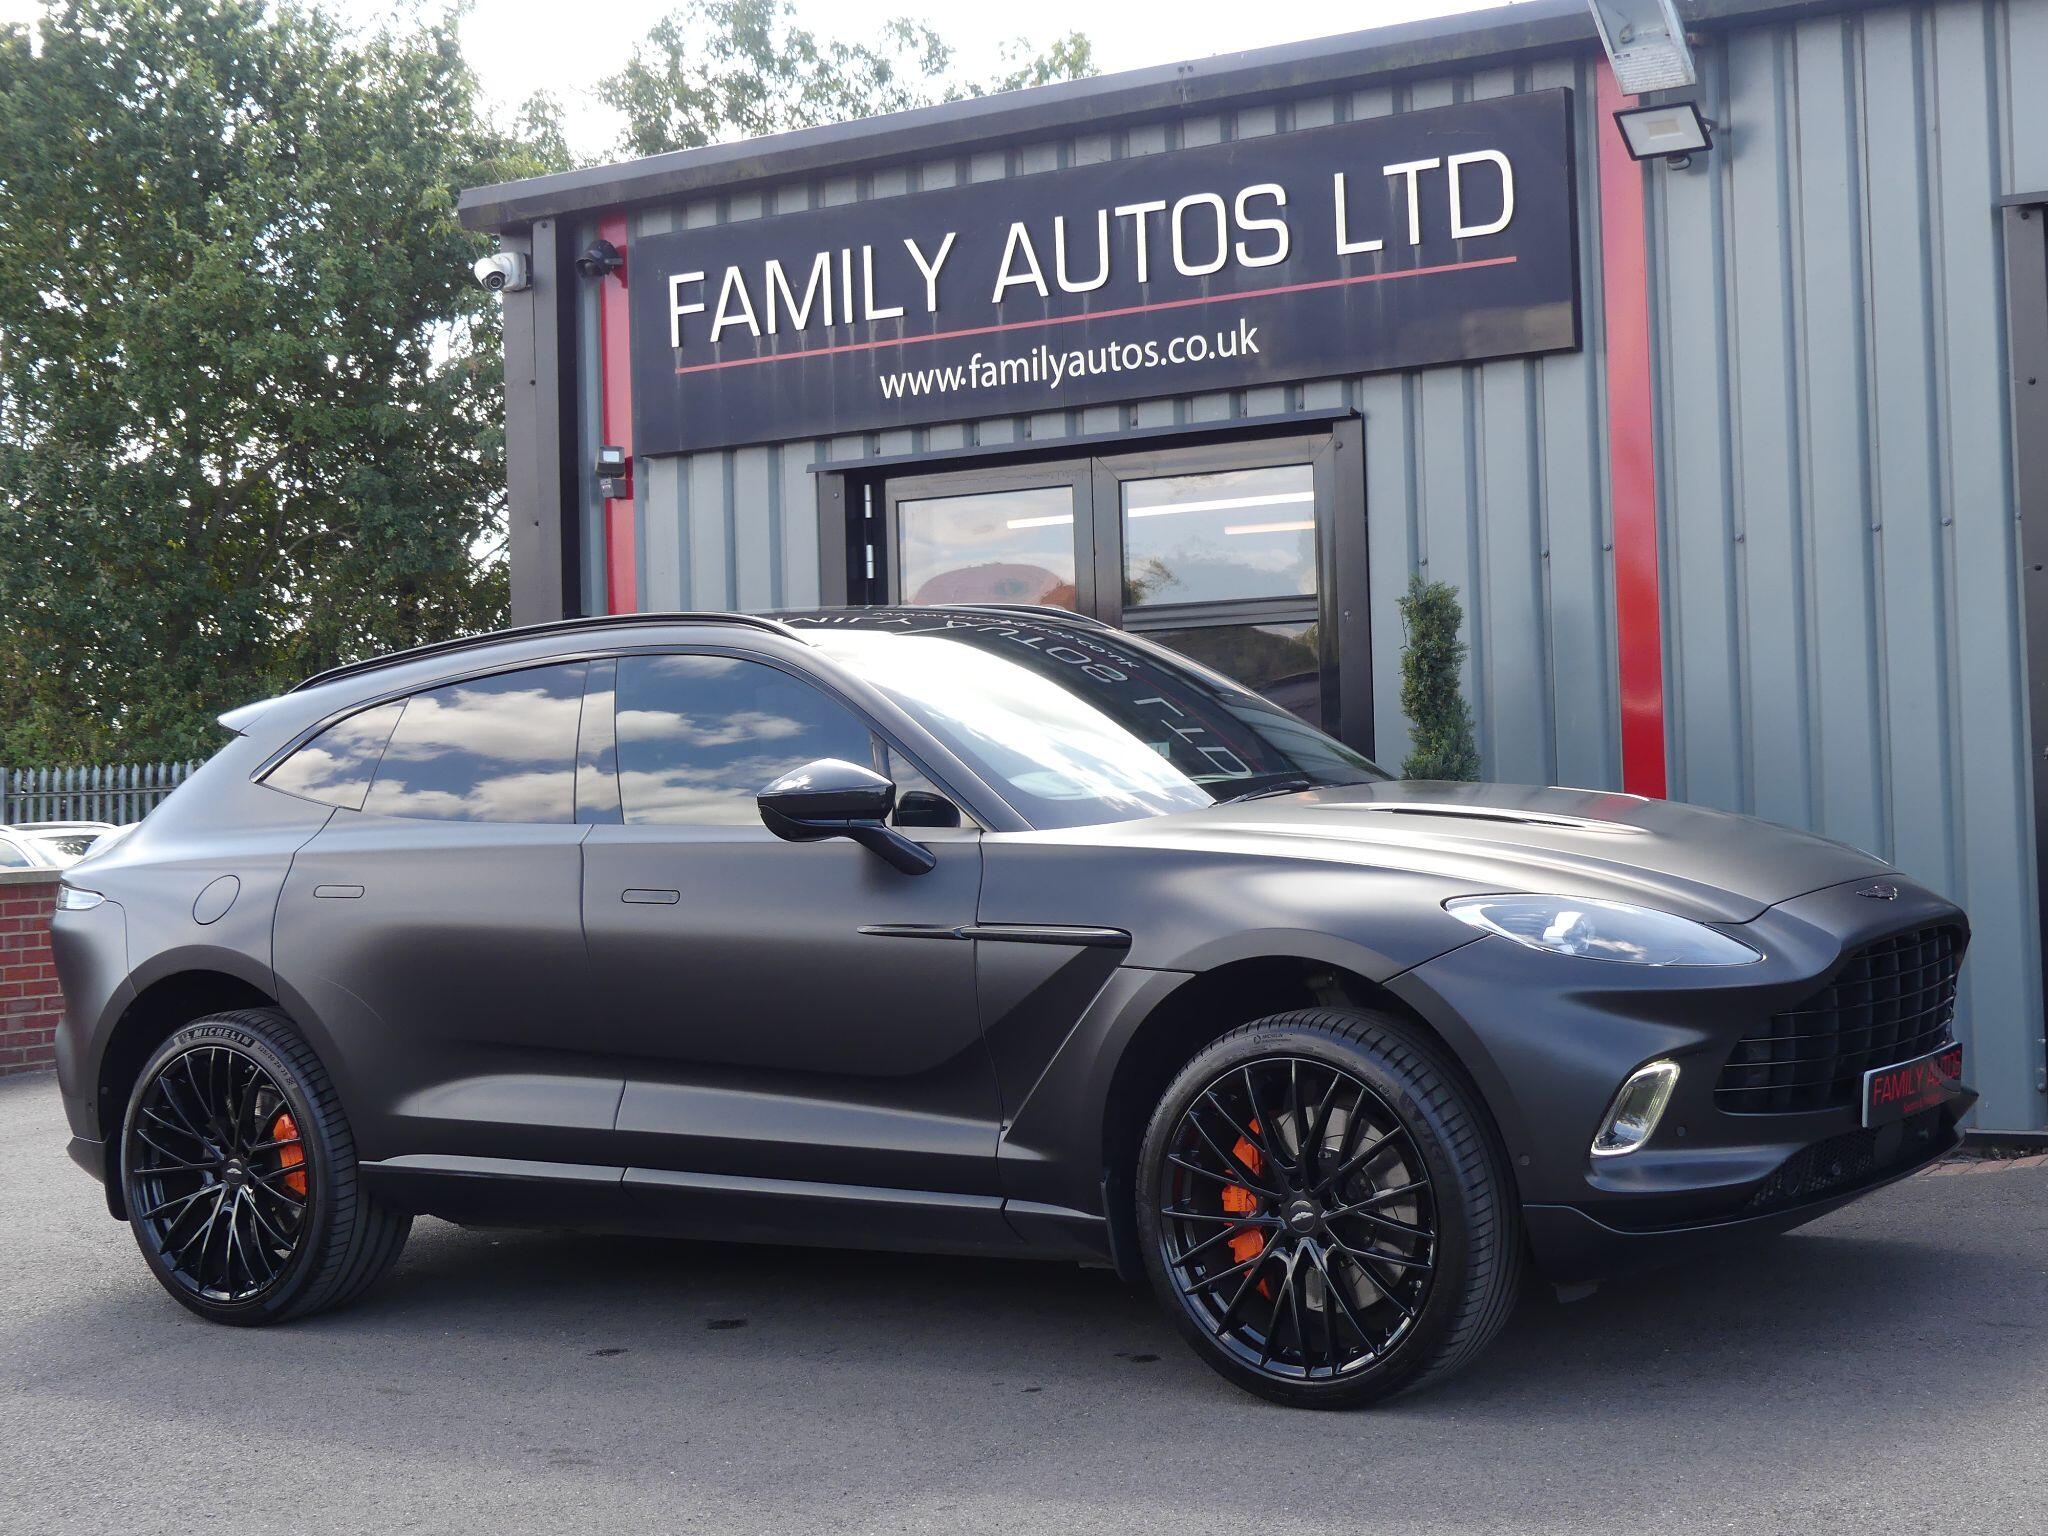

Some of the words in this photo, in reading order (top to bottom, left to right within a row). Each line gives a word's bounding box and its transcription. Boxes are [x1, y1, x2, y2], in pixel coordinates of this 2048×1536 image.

[668, 232, 957, 348] FAMILY
[991, 183, 1290, 303] AUTOS
[1333, 149, 1515, 256] LTD
[879, 318, 1260, 399] www.familyautos.co.uk
[193, 1027, 252, 1045] MICHELIN
[1873, 1064, 1923, 1106] FAMILY
